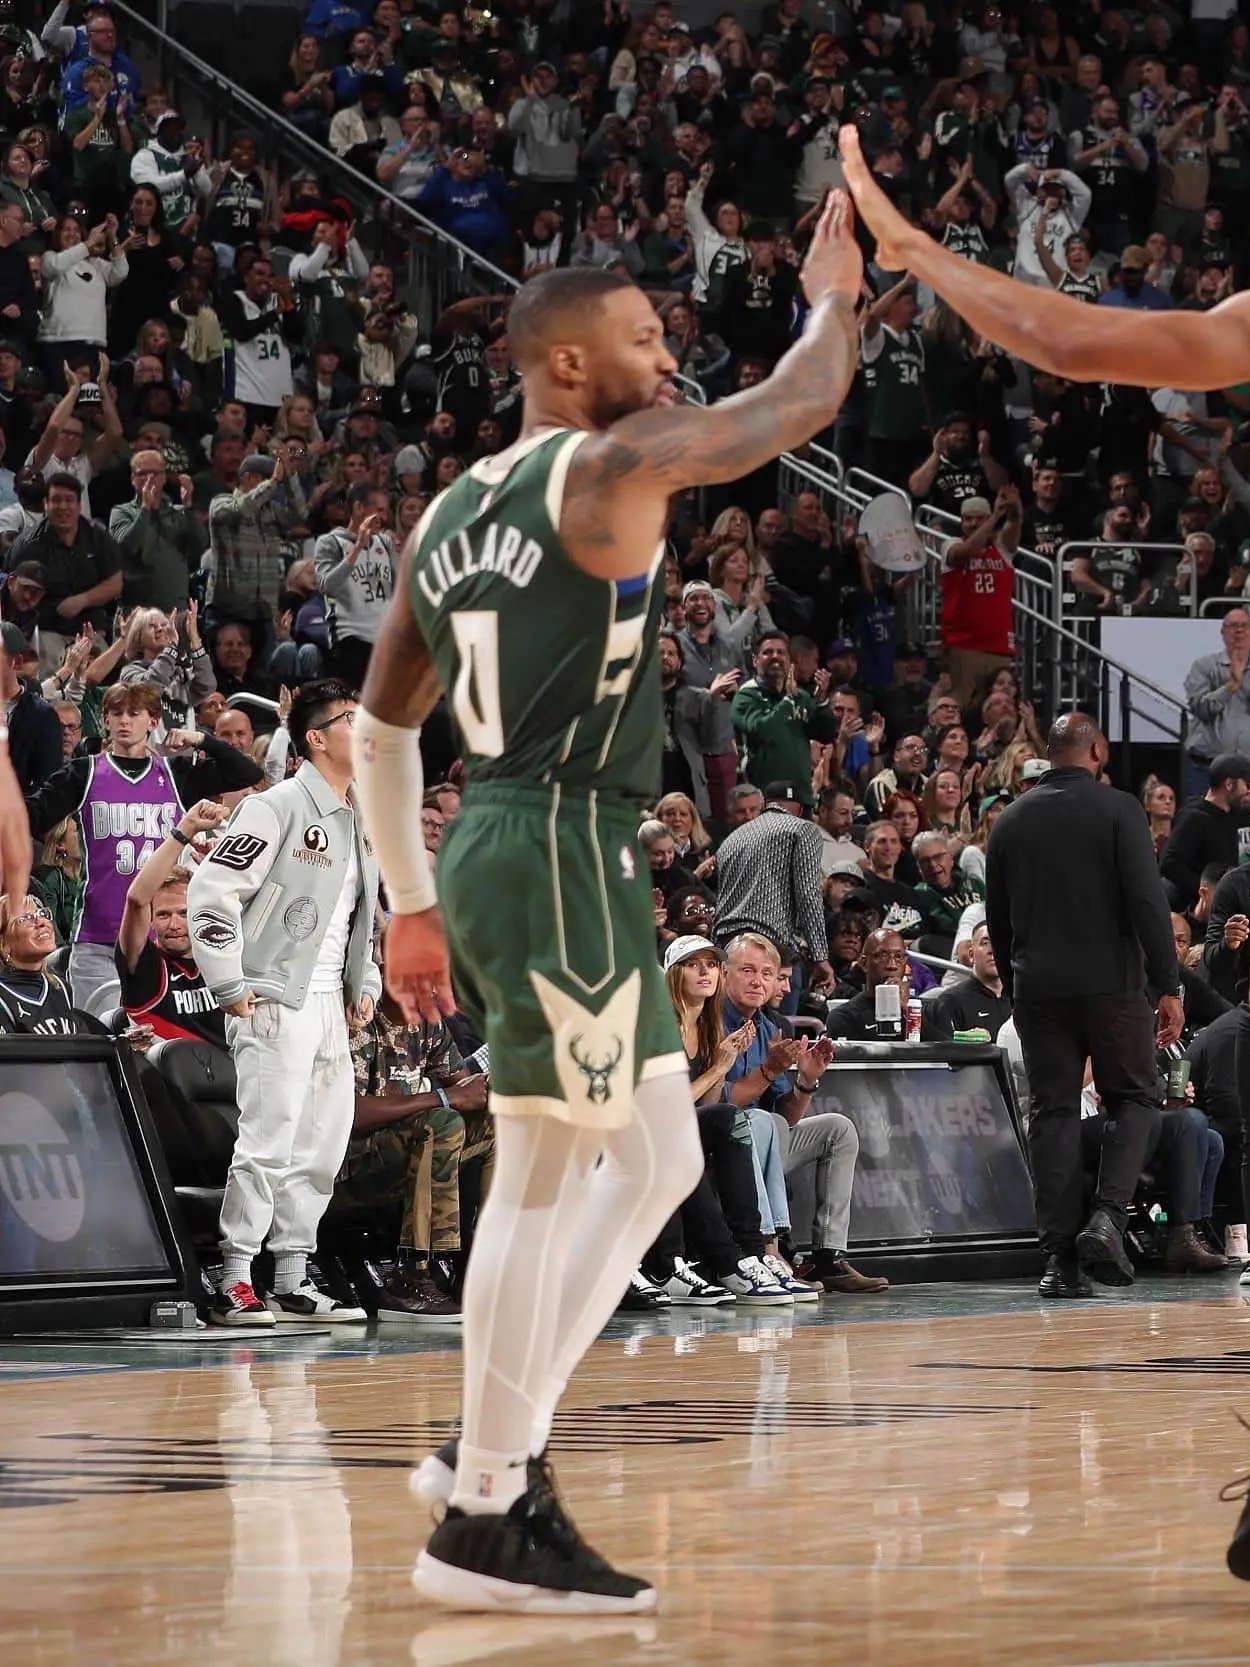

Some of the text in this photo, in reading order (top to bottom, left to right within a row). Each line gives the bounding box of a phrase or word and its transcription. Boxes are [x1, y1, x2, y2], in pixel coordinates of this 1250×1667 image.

[1097, 171, 1117, 186] 34
[231, 208, 253, 226] 34
[257, 338, 281, 361] 34
[468, 366, 480, 387] 0
[898, 362, 919, 386] 34
[350, 562, 392, 584] BUCKS
[417, 522, 544, 608] LILLARD
[360, 579, 386, 603] 34
[974, 573, 995, 593] 22
[450, 610, 504, 758] 0
[90, 801, 178, 841] BUCKS
[888, 1094, 996, 1137] LAKERS
[0, 1144, 80, 1202] TNT
[853, 1169, 921, 1209] NEXT
